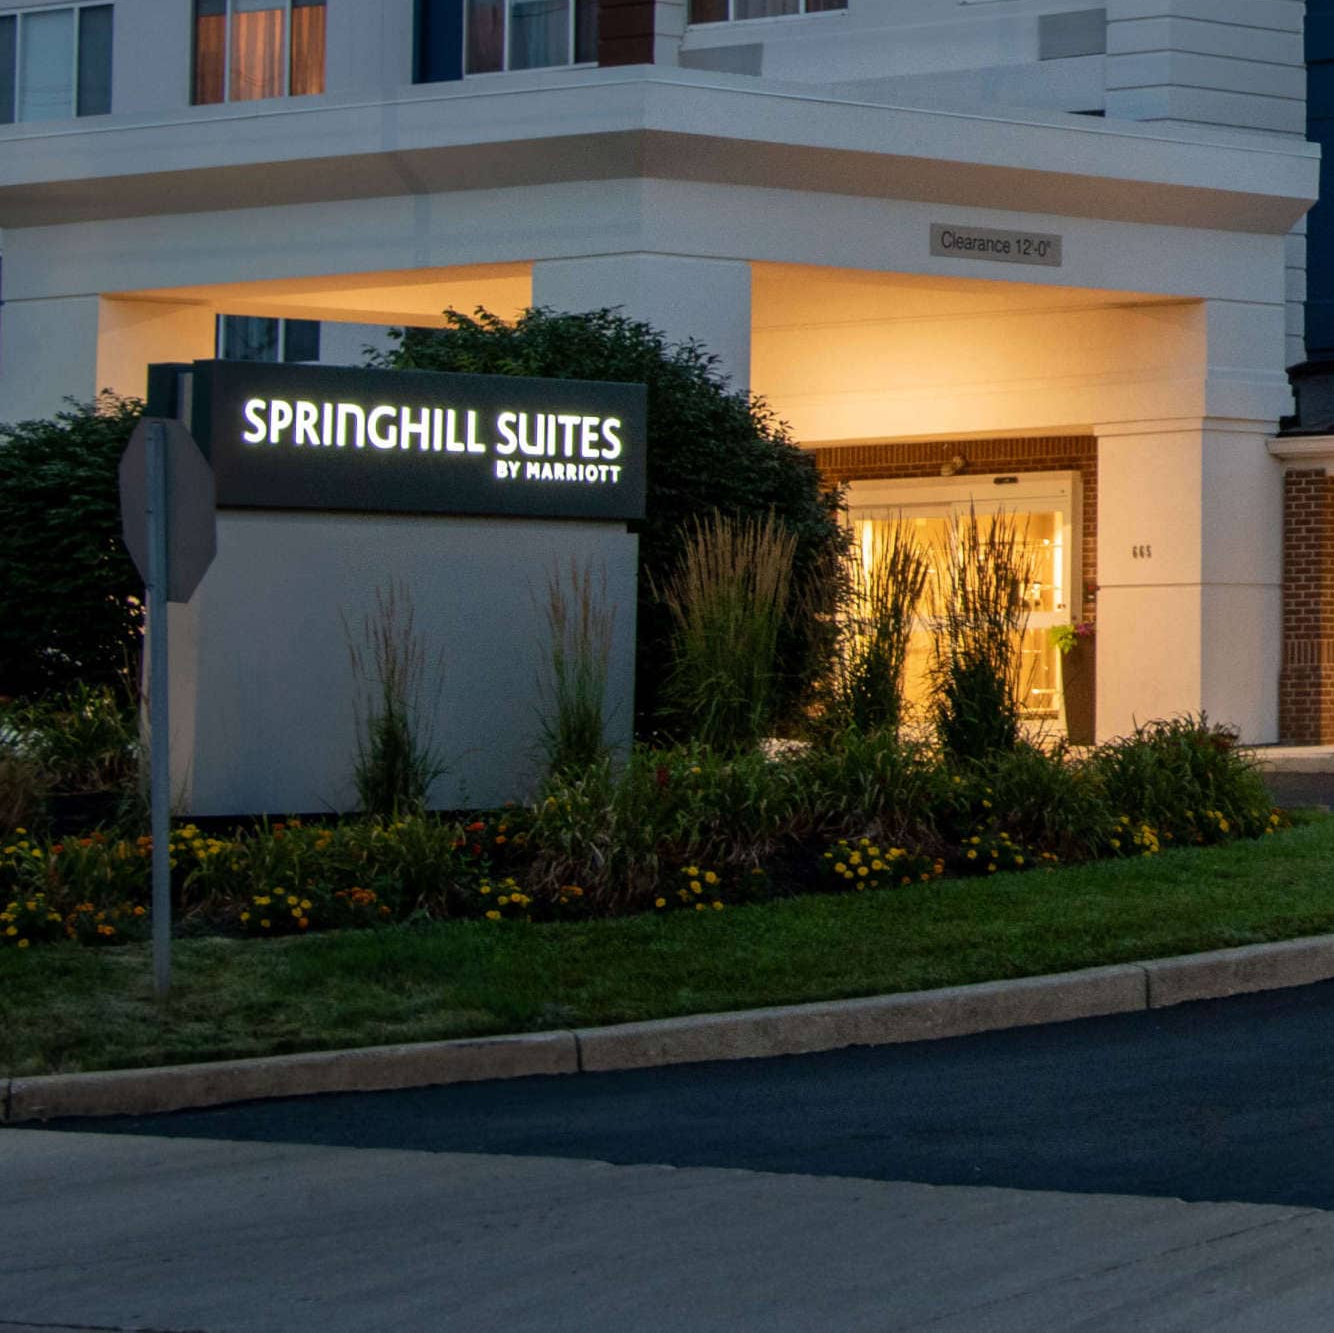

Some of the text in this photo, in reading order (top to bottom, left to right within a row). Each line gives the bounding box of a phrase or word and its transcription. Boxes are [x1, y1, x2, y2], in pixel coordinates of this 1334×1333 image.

[941, 231, 1010, 254] Clearance
[242, 398, 622, 459] SPRINGHILL SUITES
[495, 460, 622, 483] BY MARRIOTT
